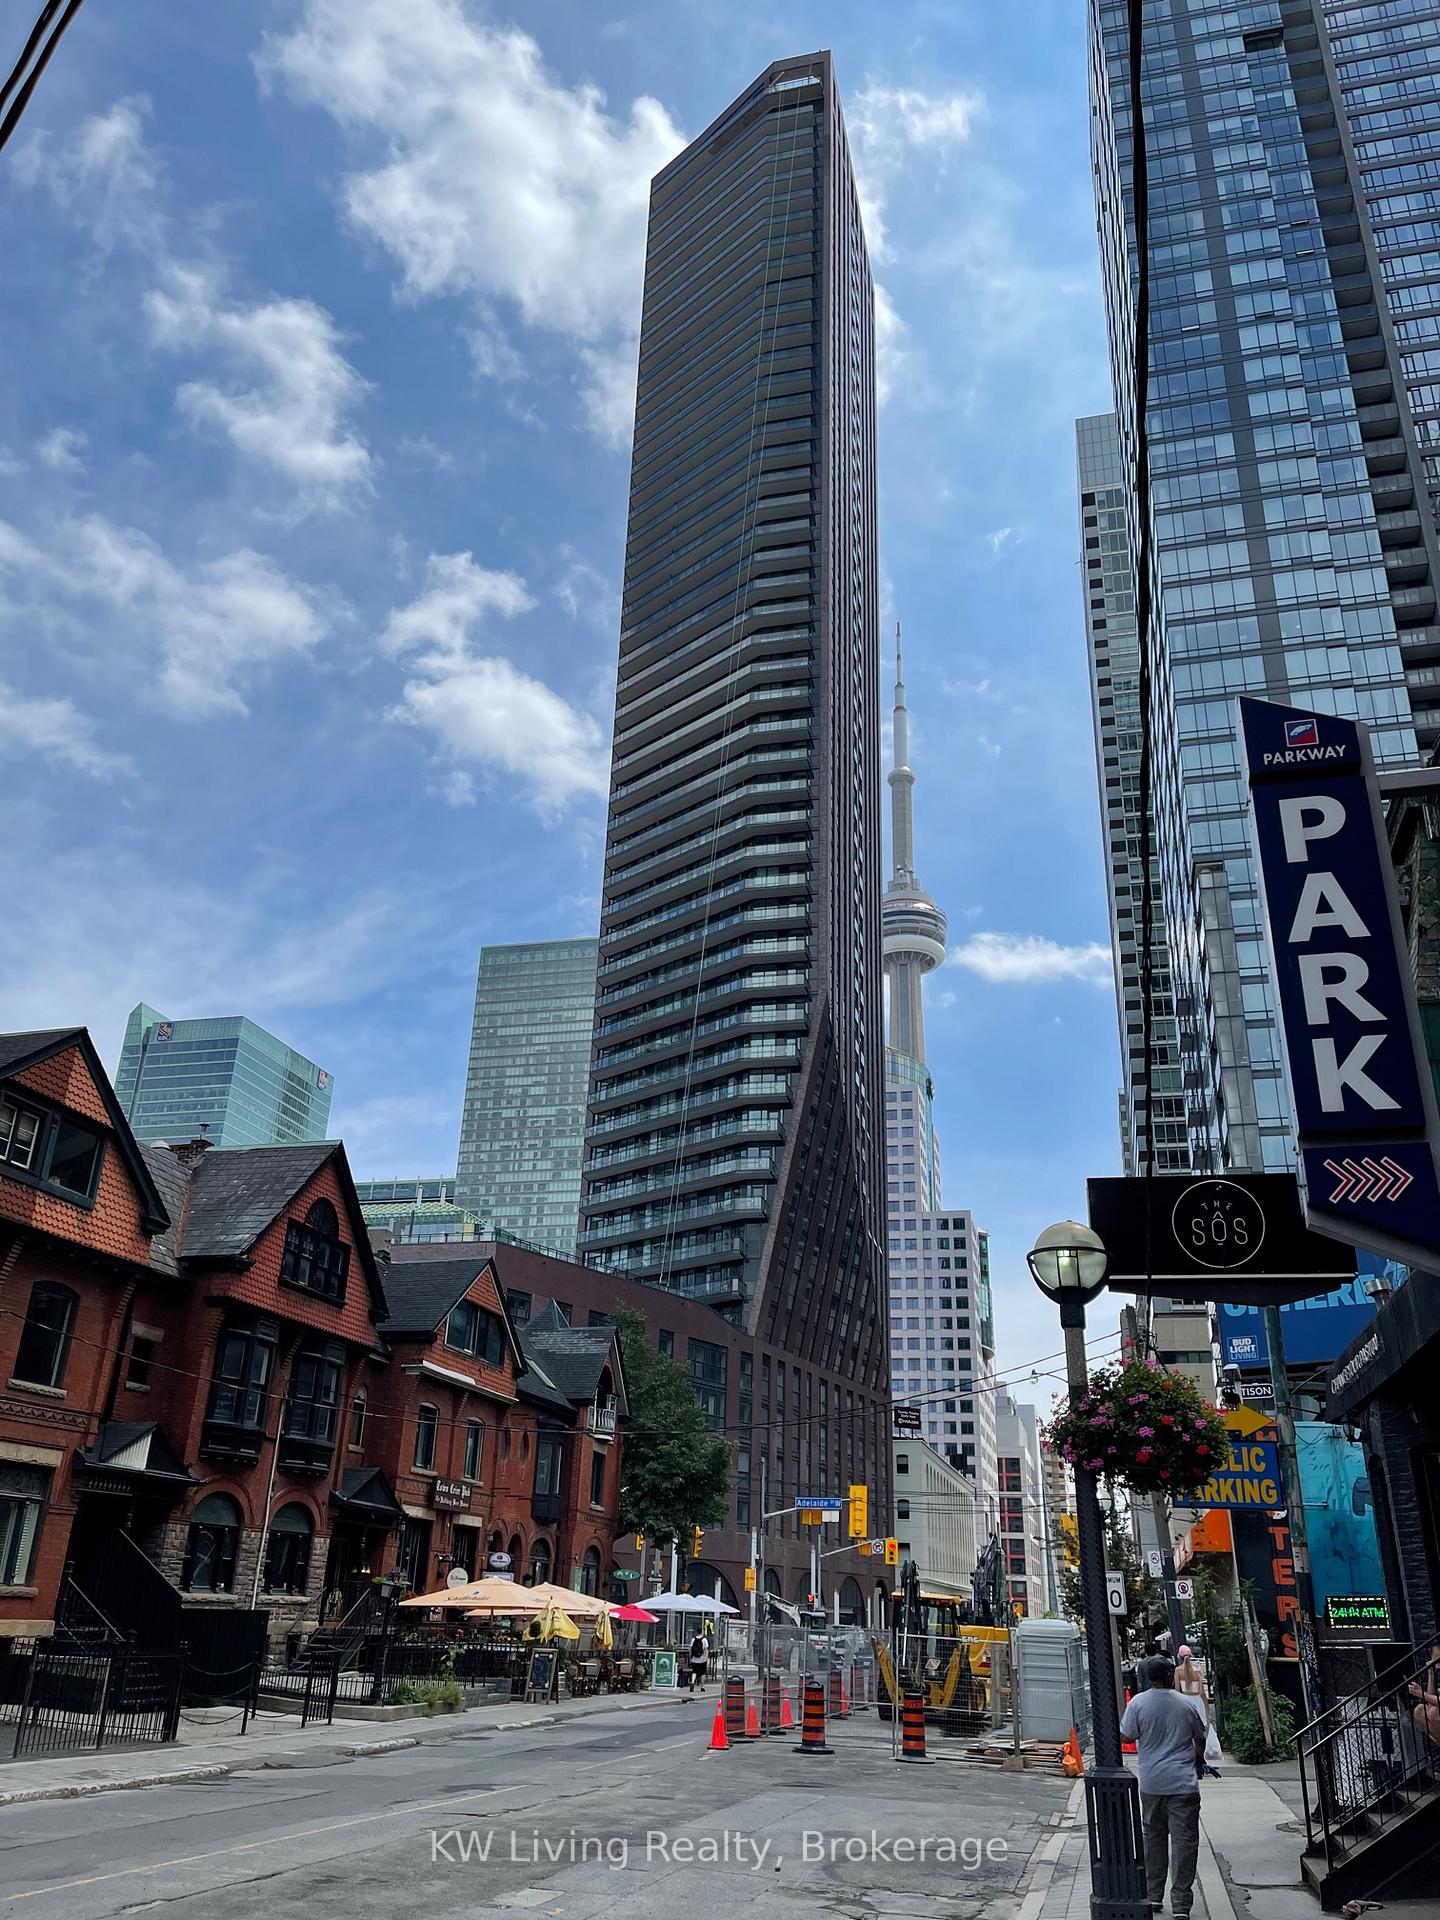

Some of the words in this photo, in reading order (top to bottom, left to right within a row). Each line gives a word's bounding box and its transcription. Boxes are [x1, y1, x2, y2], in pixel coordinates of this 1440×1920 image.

[1263, 745, 1346, 765] PARKWAY
[1278, 795, 1402, 1113] PARK
[1201, 1200, 1232, 1210] THE
[1232, 1338, 1251, 1347] BUD
[1230, 1345, 1256, 1354] LIGHT
[1231, 1352, 1257, 1360] LIVING
[1235, 1386, 1271, 1396] TISON
[1109, 1589, 1122, 1609] 0
[1331, 1607, 1360, 1618] 24HR
[1361, 1607, 1385, 1618] ATM
